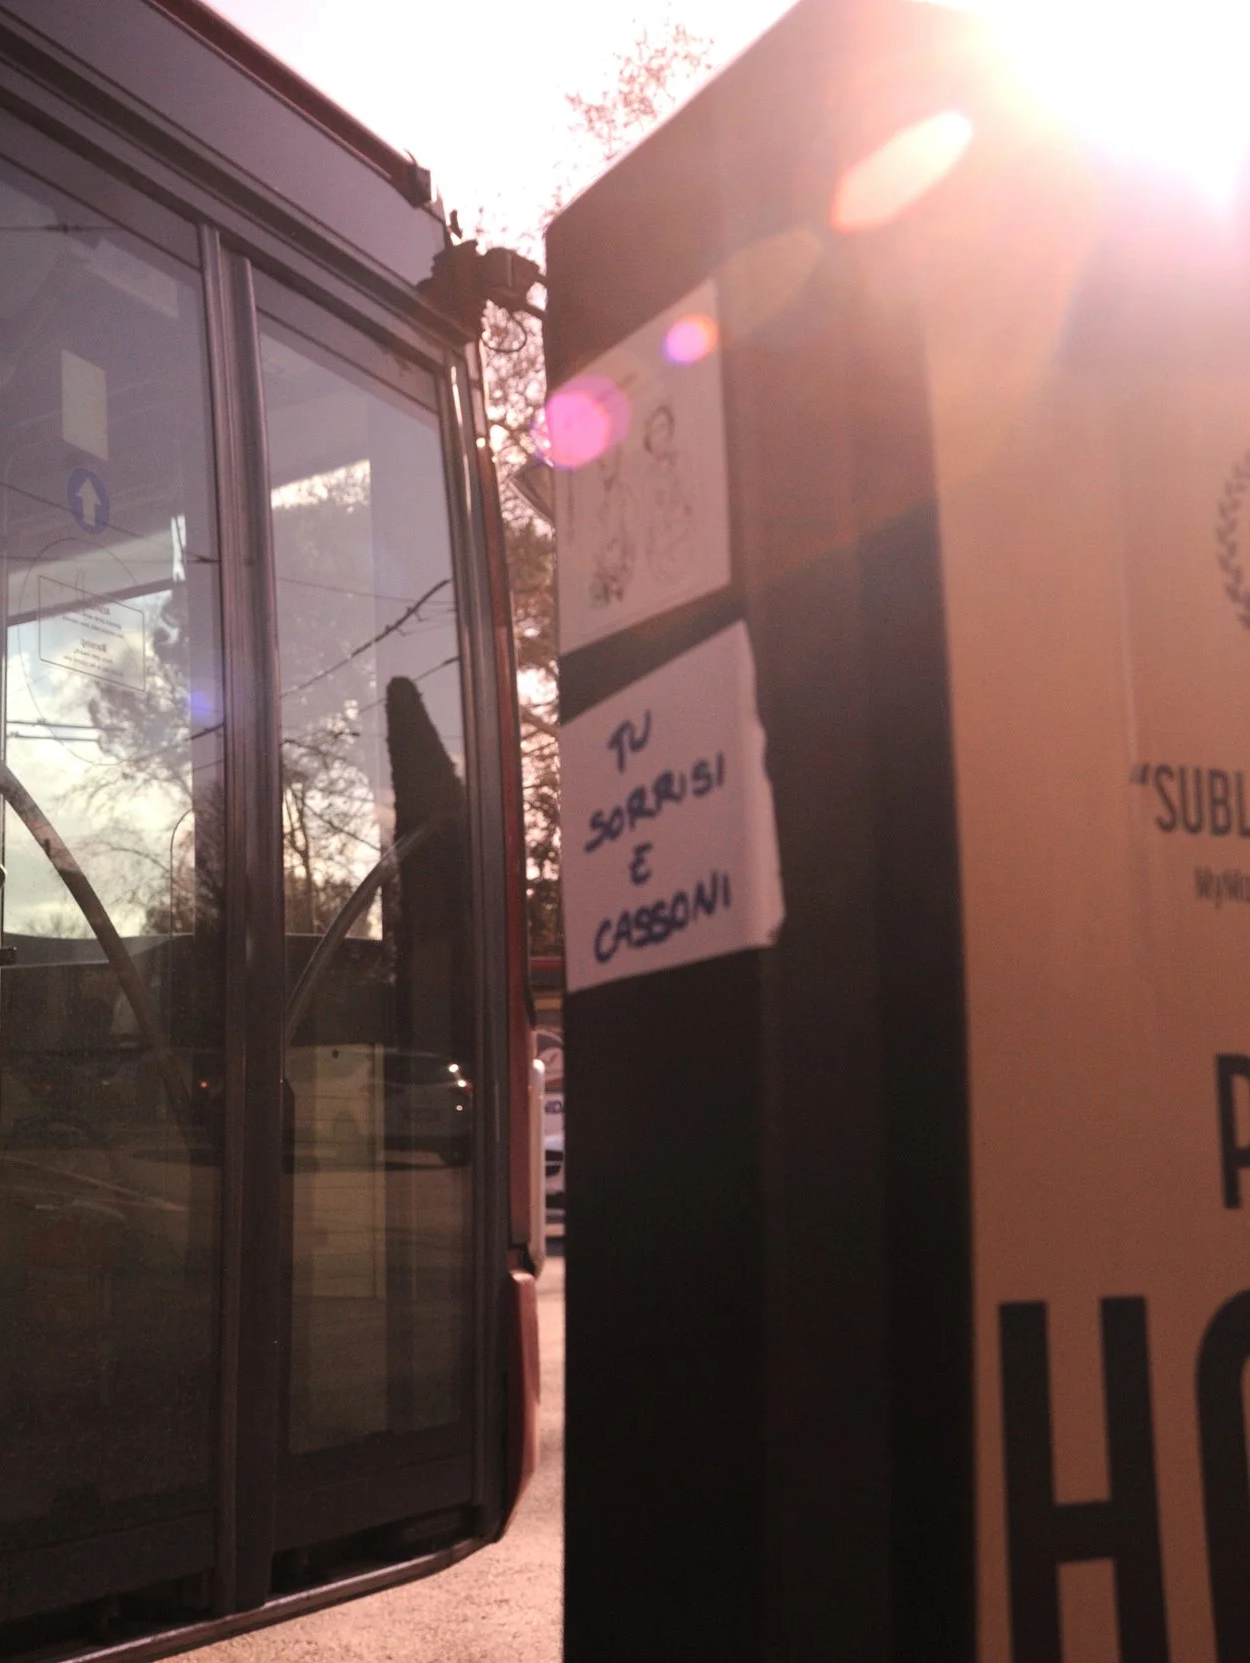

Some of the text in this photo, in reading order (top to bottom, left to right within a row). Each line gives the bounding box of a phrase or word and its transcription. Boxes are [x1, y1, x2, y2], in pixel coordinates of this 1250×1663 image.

[607, 709, 651, 774] TU
[584, 751, 726, 853] SORRISI
[629, 841, 652, 885] E
[594, 872, 732, 963] CASSONI
